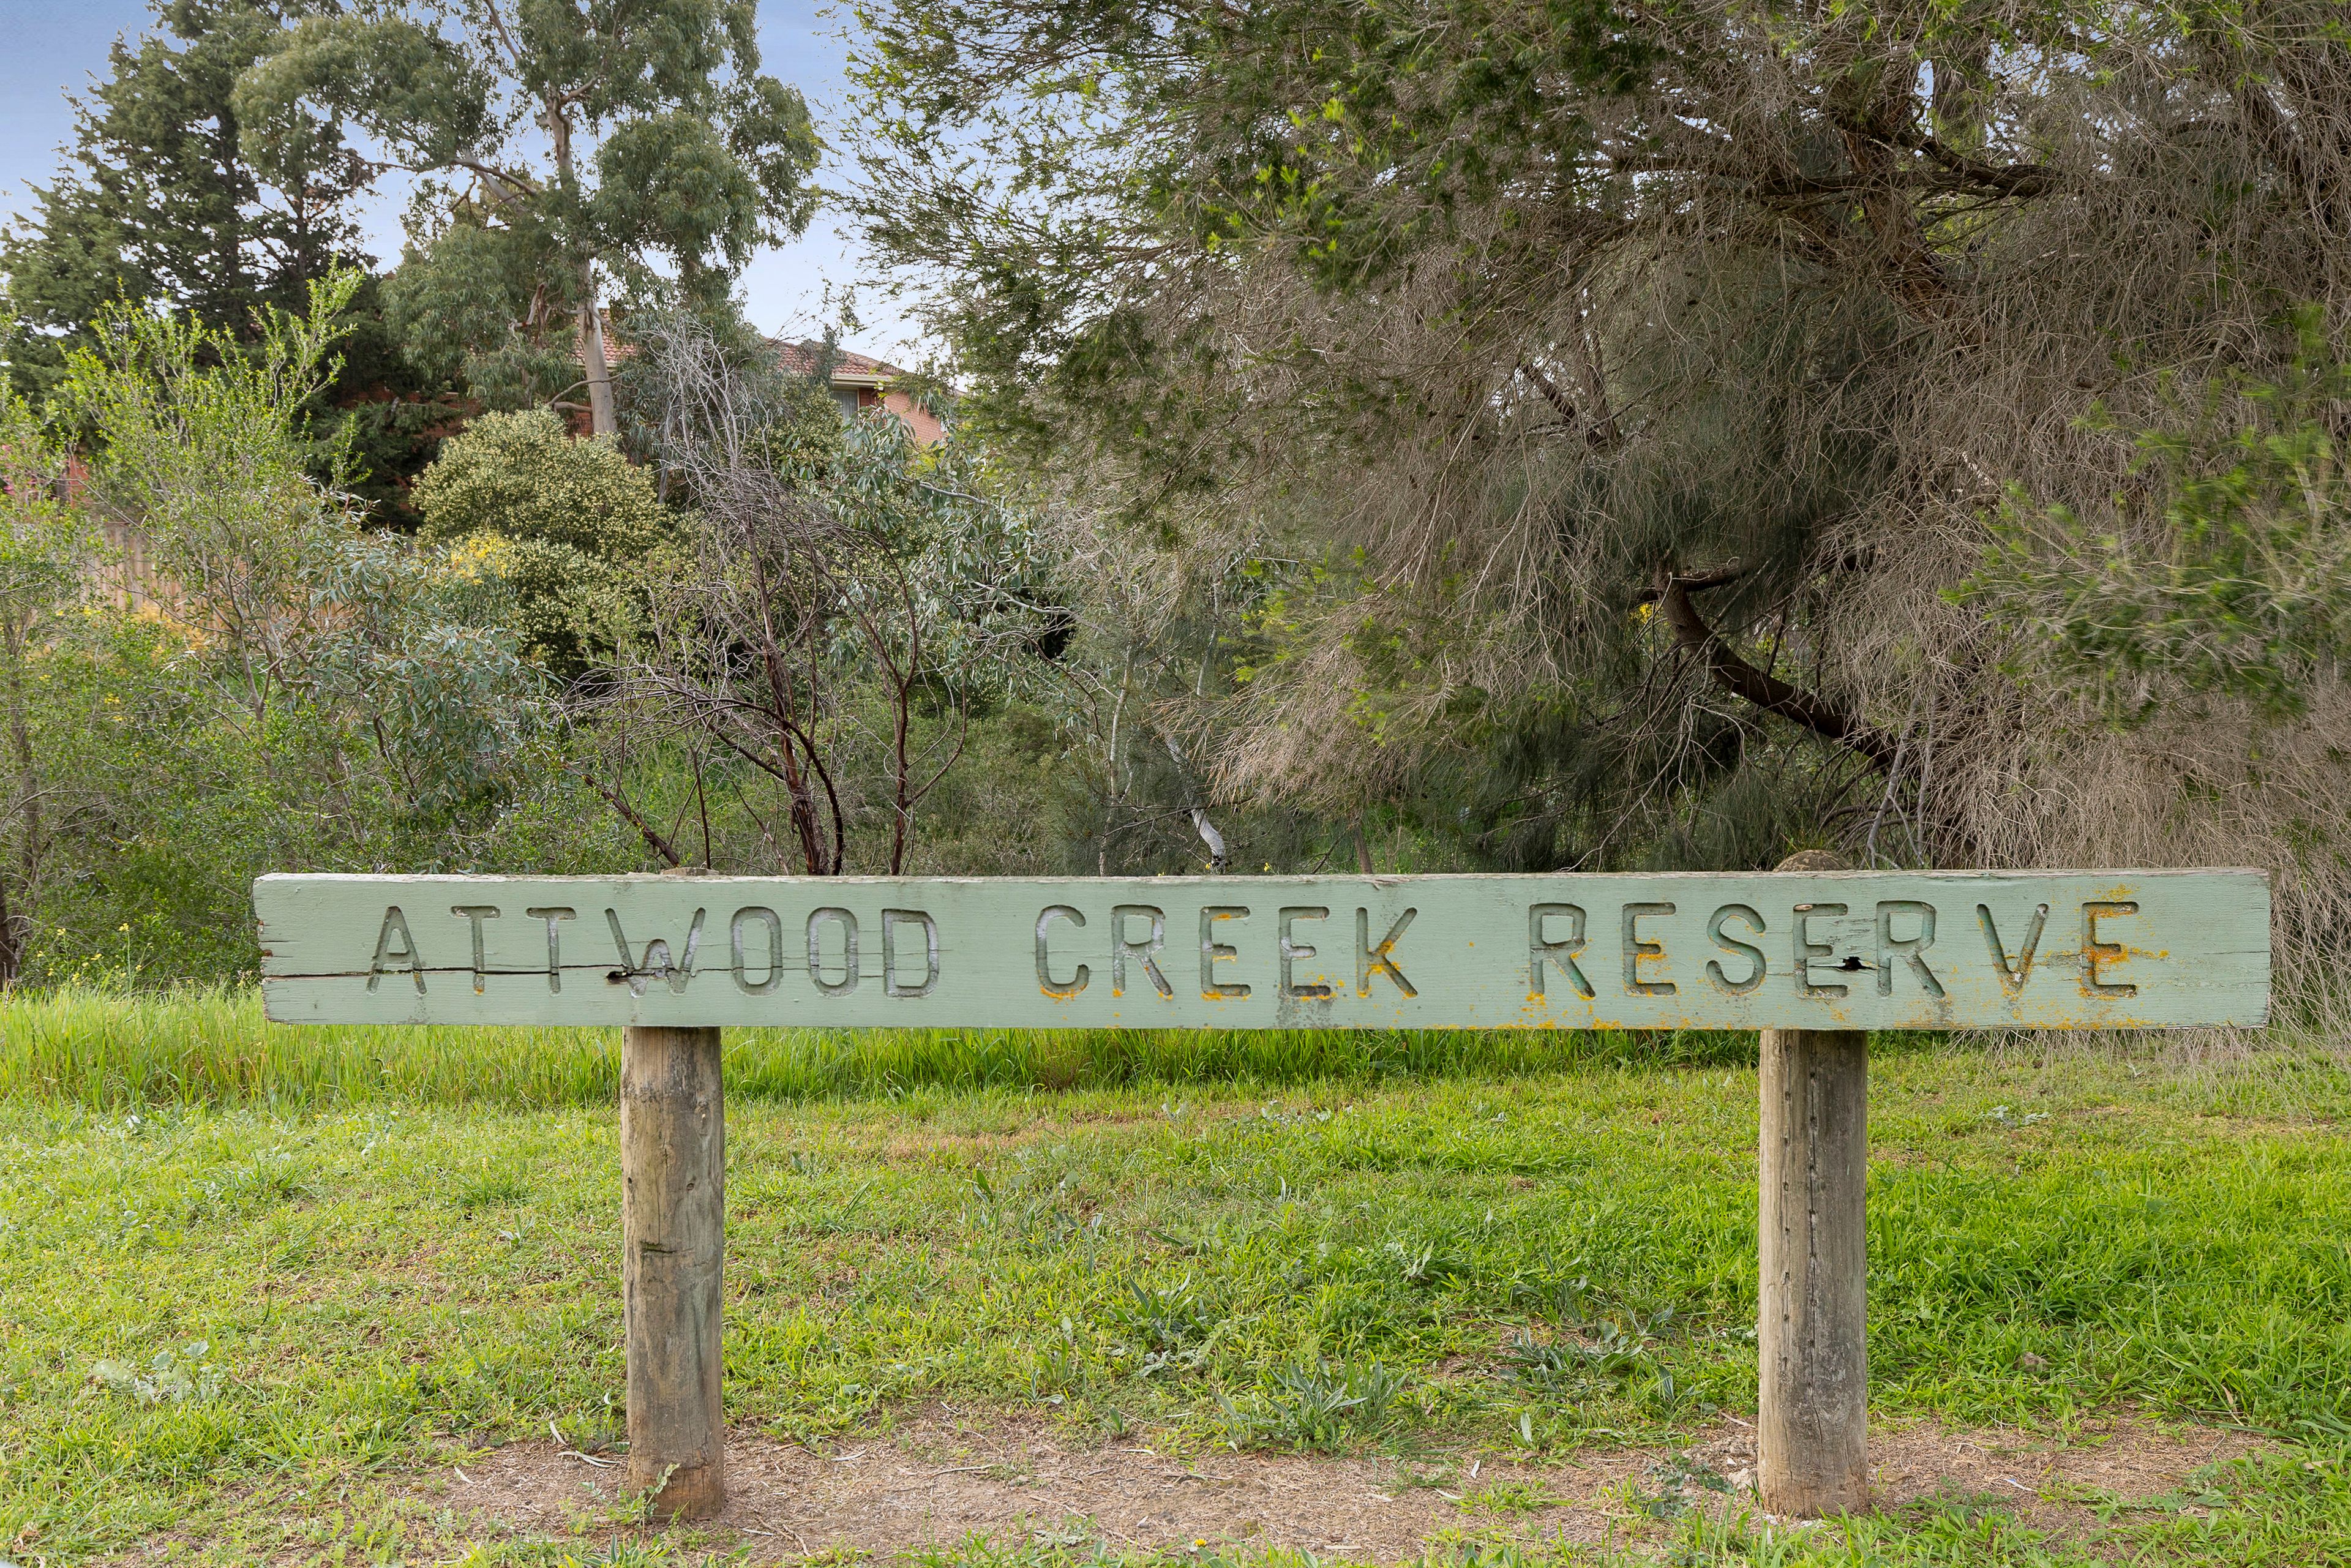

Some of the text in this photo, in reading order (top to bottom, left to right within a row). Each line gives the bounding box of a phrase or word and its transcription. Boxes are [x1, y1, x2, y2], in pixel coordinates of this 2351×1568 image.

[366, 901, 2139, 999] ATTWOOD CREEK RESERVE
